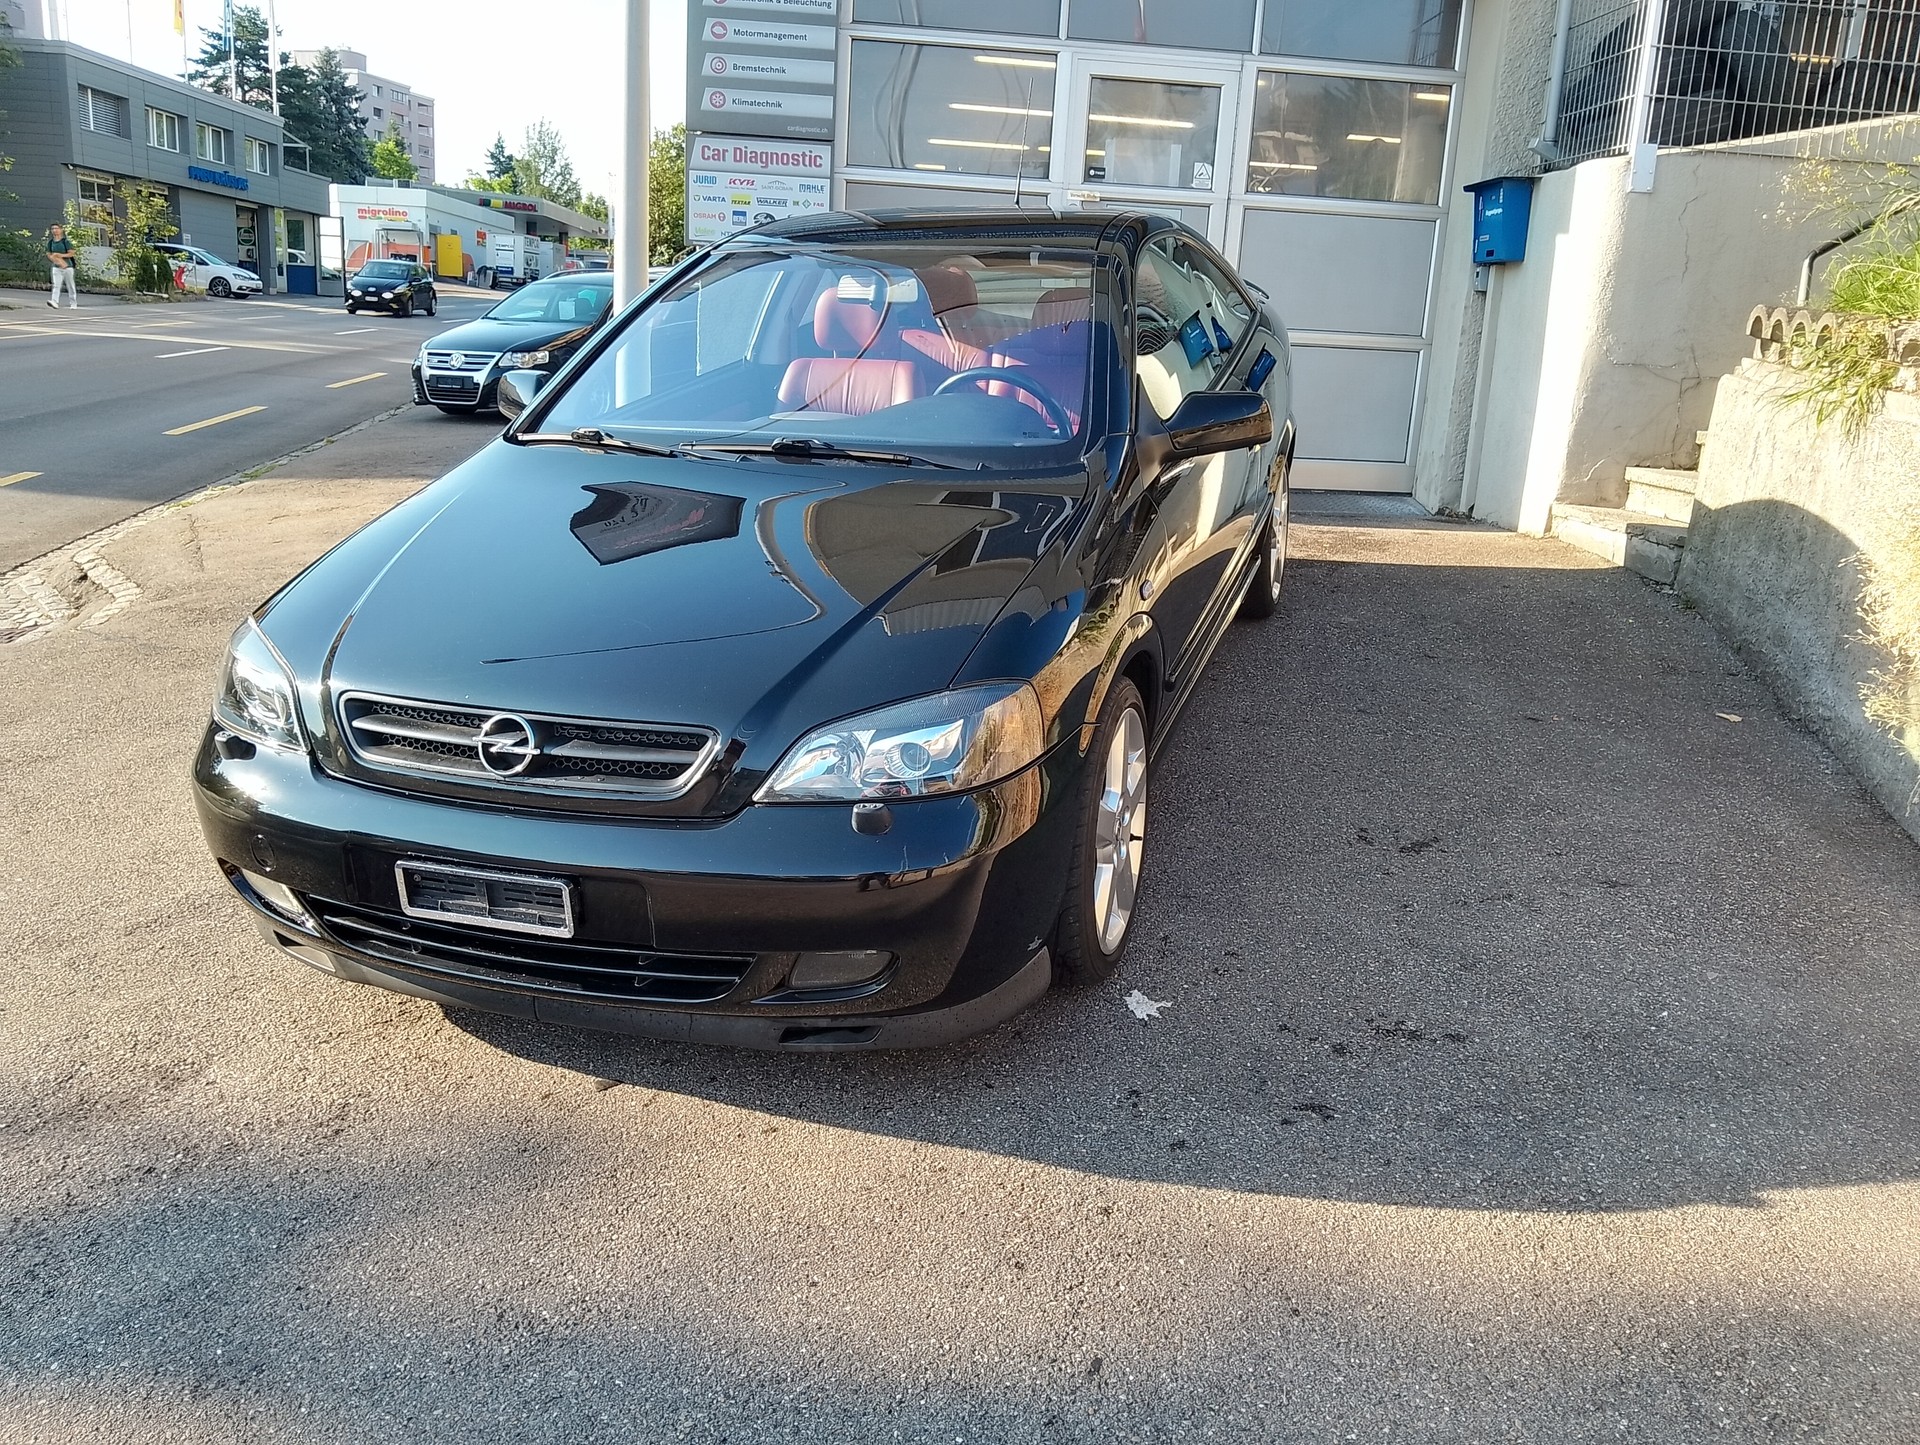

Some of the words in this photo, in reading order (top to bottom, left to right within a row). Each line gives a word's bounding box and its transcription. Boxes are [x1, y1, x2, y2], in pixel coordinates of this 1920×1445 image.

[733, 28, 808, 42] Motormanagement
[732, 63, 787, 75] Bremstechnik
[731, 98, 783, 109] Klimatechnik
[701, 145, 728, 161] Car
[733, 146, 823, 168] Diagnostic
[693, 175, 717, 185] JURID
[799, 183, 825, 191] MAHLE
[702, 195, 727, 203] VARTA
[756, 197, 788, 207] WALKER
[357, 206, 408, 218] migrolino
[503, 200, 539, 213] MIGROL
[693, 212, 717, 220] OSRAM
